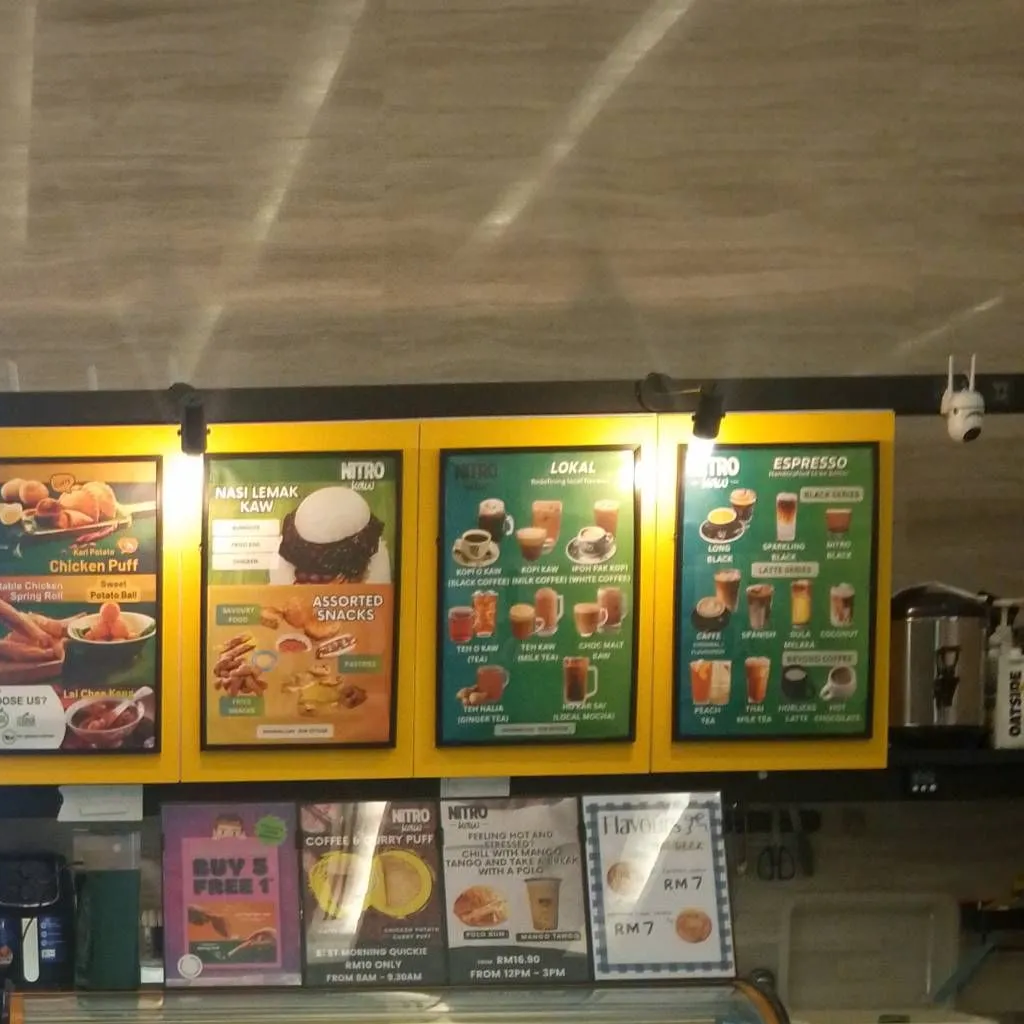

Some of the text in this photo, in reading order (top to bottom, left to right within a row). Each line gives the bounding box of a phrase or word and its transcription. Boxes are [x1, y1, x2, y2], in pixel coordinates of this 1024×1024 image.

[550, 461, 596, 474] LOKAL
[773, 456, 848, 470] ESPRESSO
[341, 461, 384, 480] NITRO
[215, 486, 298, 499] NASI LEMAK
[240, 500, 274, 512] KAW
[708, 544, 731, 553] LONG
[763, 542, 805, 550] SPARKLING
[707, 554, 733, 564] BLACK
[771, 552, 796, 561] BLACK
[826, 551, 852, 560] BLACK
[50, 559, 138, 572] Chicken Puff
[521, 566, 539, 574] KOPI
[609, 564, 628, 572] KOPI
[758, 566, 782, 574] LATTE
[456, 568, 475, 576] KOPI
[24, 582, 63, 590] Chicken
[100, 580, 126, 588] Sweet
[10, 591, 63, 601] Spring Roll
[90, 591, 137, 600] Potato Ball
[312, 595, 383, 608] ASSORTED
[317, 608, 374, 621] SNACKS
[228, 616, 248, 624] FOOD
[742, 630, 776, 639] SPANISH
[481, 644, 499, 652] KAW
[468, 656, 488, 664] (TEA)
[592, 652, 610, 660] KAW
[26, 696, 47, 705] US?
[1008, 670, 1022, 737] OATSIDE
[746, 705, 764, 713] THAI
[701, 717, 716, 725] TEA
[758, 715, 772, 723] TEA
[392, 808, 430, 823] NITRO
[448, 806, 488, 820] NITRO
[306, 834, 434, 846] COFFEE PUFF
[468, 832, 506, 840] FEELING
[533, 831, 553, 839] AND
[462, 848, 562, 858] CHILL WITH MANGO
[193, 858, 268, 877] BUY 5
[446, 860, 482, 868] TANGO
[511, 858, 535, 866] TAKE
[478, 866, 544, 876] WITH A POLO
[193, 878, 254, 895] FREE
[664, 876, 702, 890] RM 7
[615, 921, 654, 936] RM 7
[341, 948, 387, 957] MORNING
[389, 947, 428, 956] QUICKIE
[345, 960, 402, 970] RM10 ONLY
[326, 974, 354, 982] FROM
[470, 968, 566, 979] FROM 12PM 3PM
